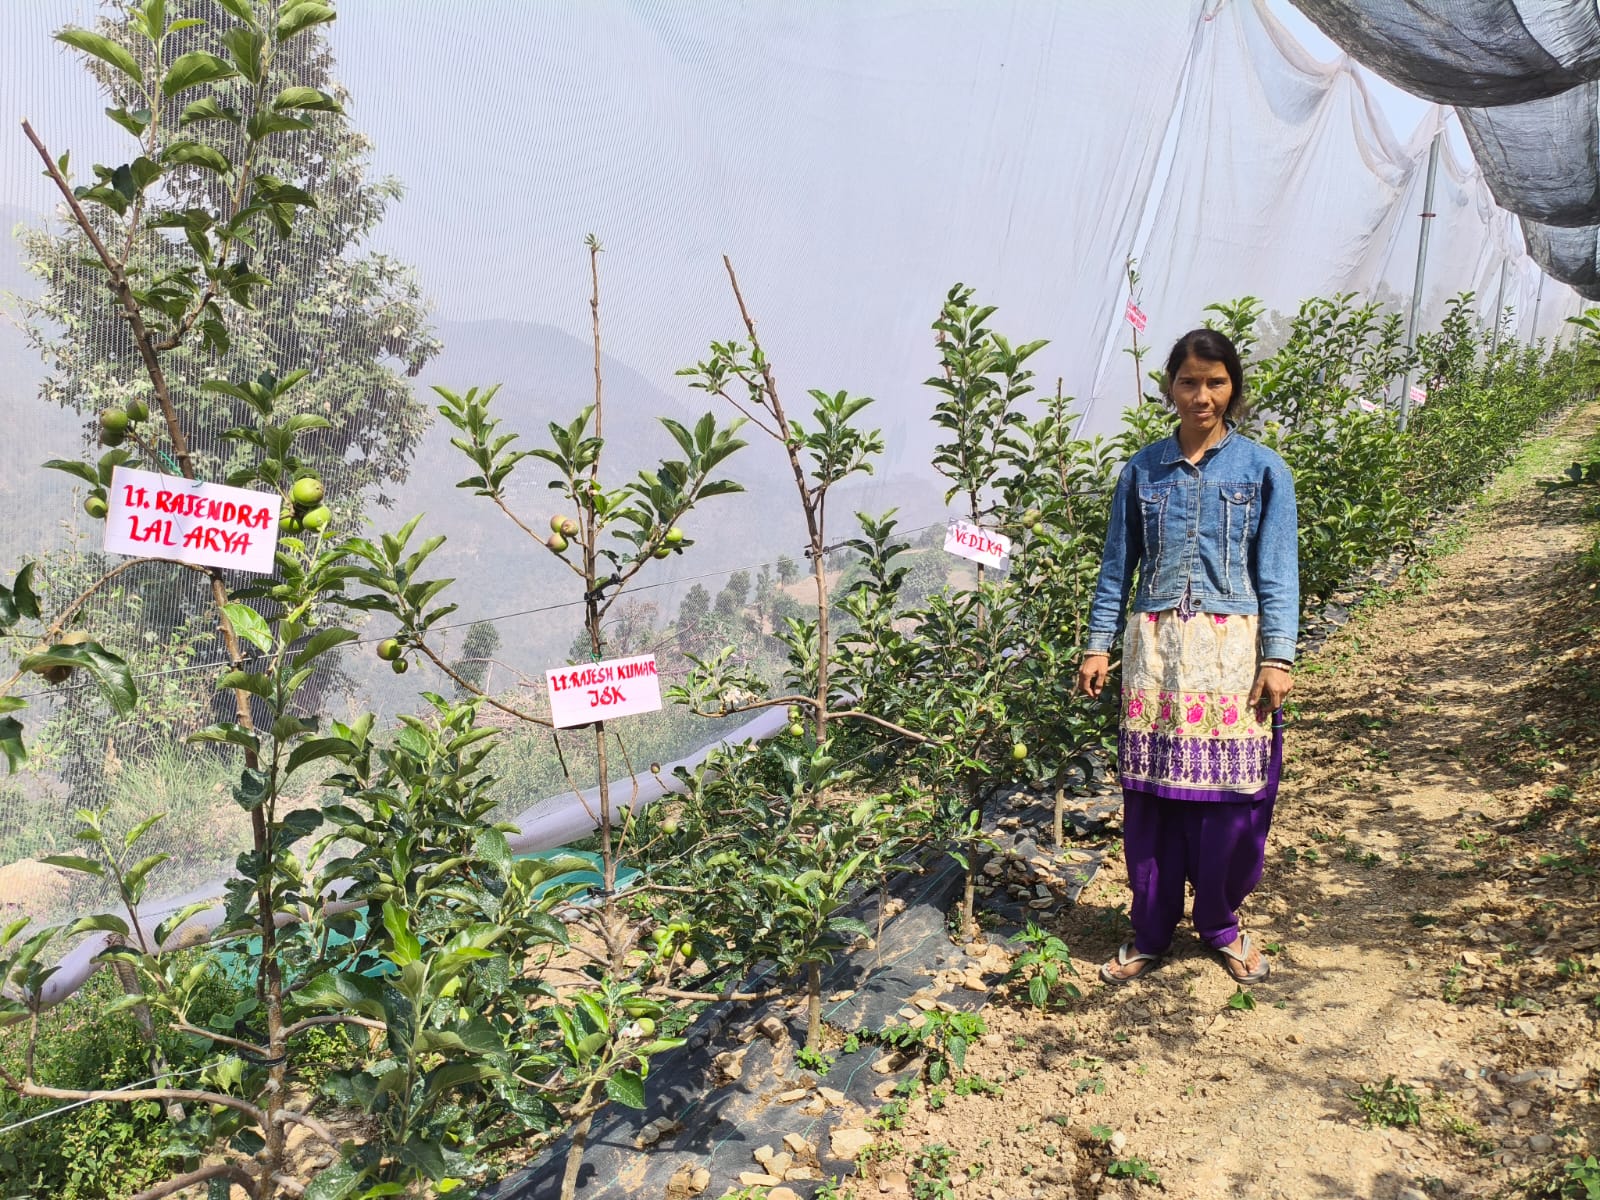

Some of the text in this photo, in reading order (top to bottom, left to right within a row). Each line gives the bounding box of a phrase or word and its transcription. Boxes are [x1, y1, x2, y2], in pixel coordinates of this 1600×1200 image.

[155, 490, 274, 530] RAJENDRA
[128, 515, 253, 555] LAL ARYA
[955, 528, 1004, 558] VEDIKA
[617, 660, 659, 680] KUMAR
